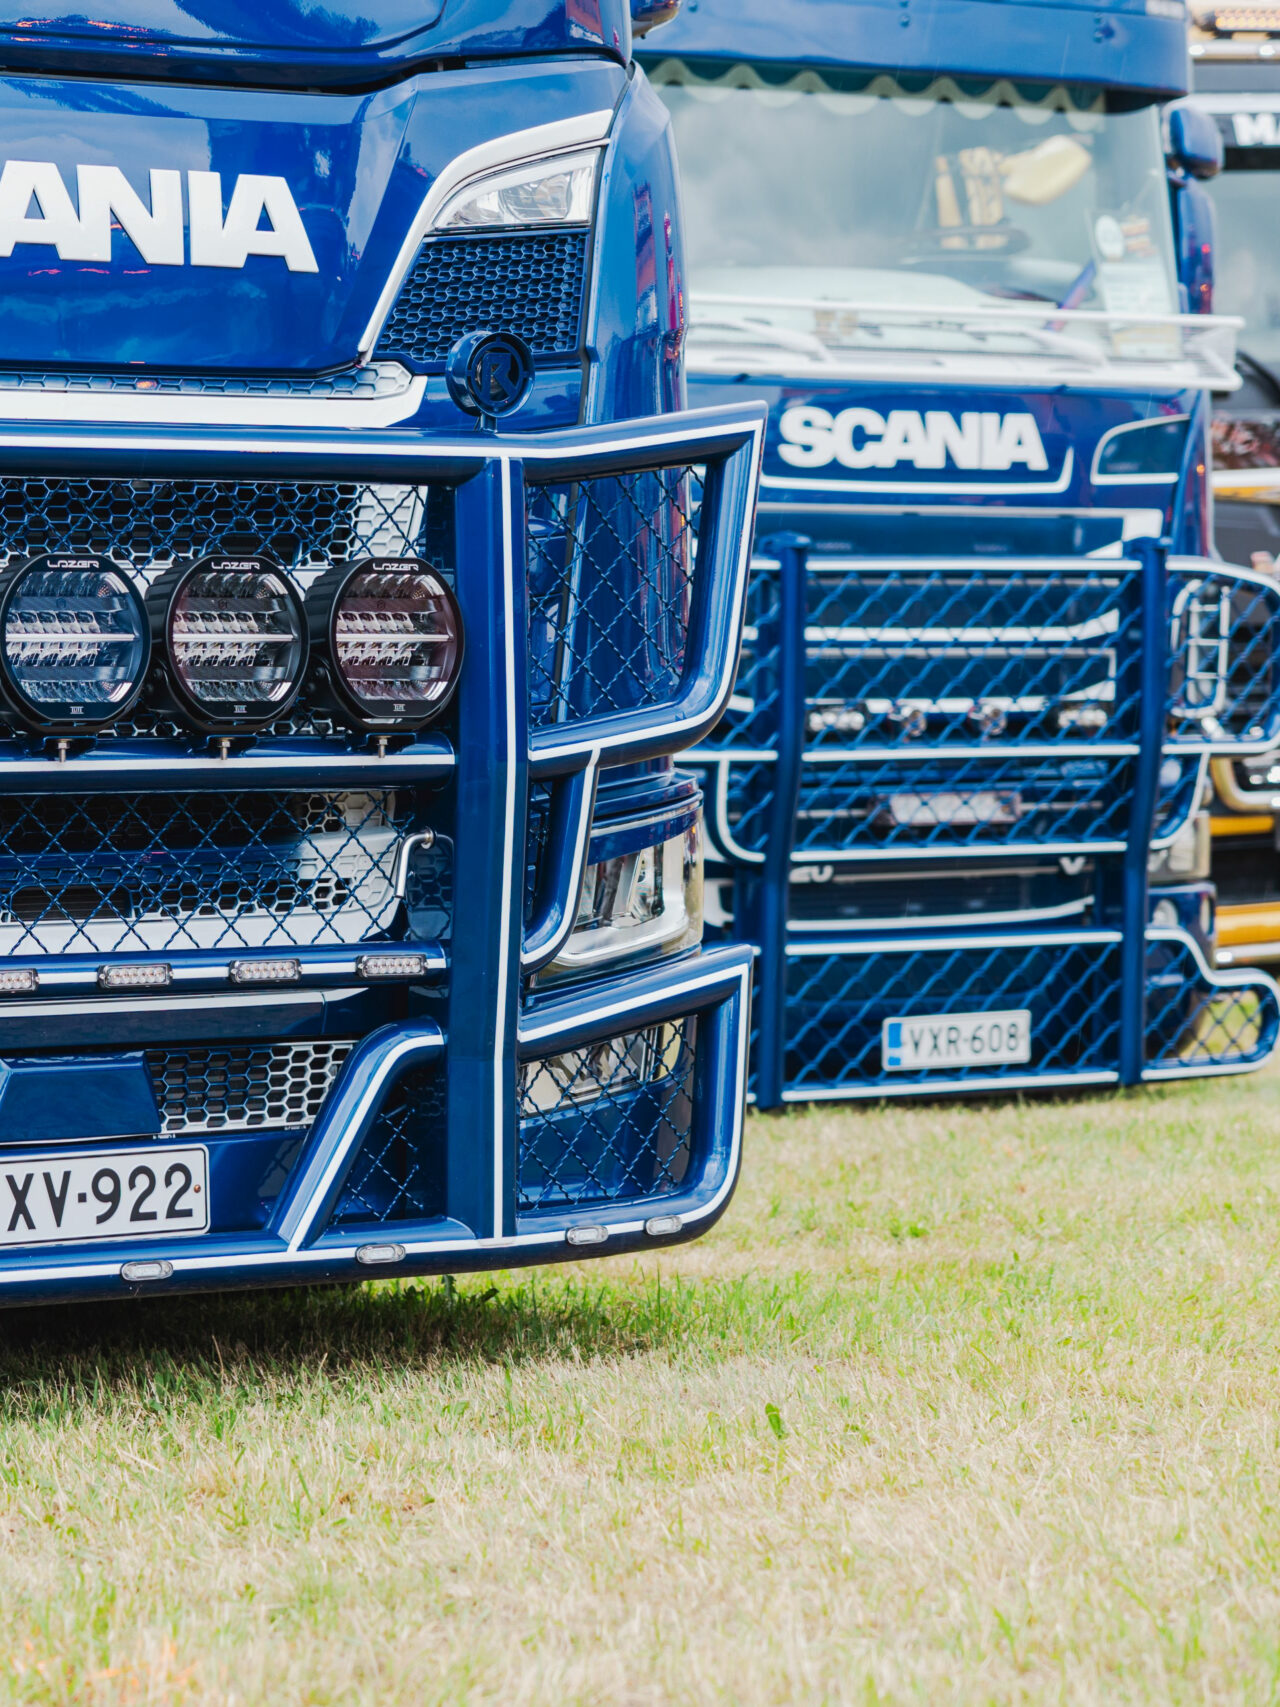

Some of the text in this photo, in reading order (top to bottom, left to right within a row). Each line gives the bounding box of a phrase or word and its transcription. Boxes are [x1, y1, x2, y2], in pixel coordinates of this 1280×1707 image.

[1231, 113, 1280, 147] M
[777, 405, 1050, 471] SCANIA
[47, 559, 100, 569] LAZER
[211, 561, 261, 570] LAZER
[372, 563, 419, 572] LAZER
[909, 1022, 1020, 1058] VXR-608
